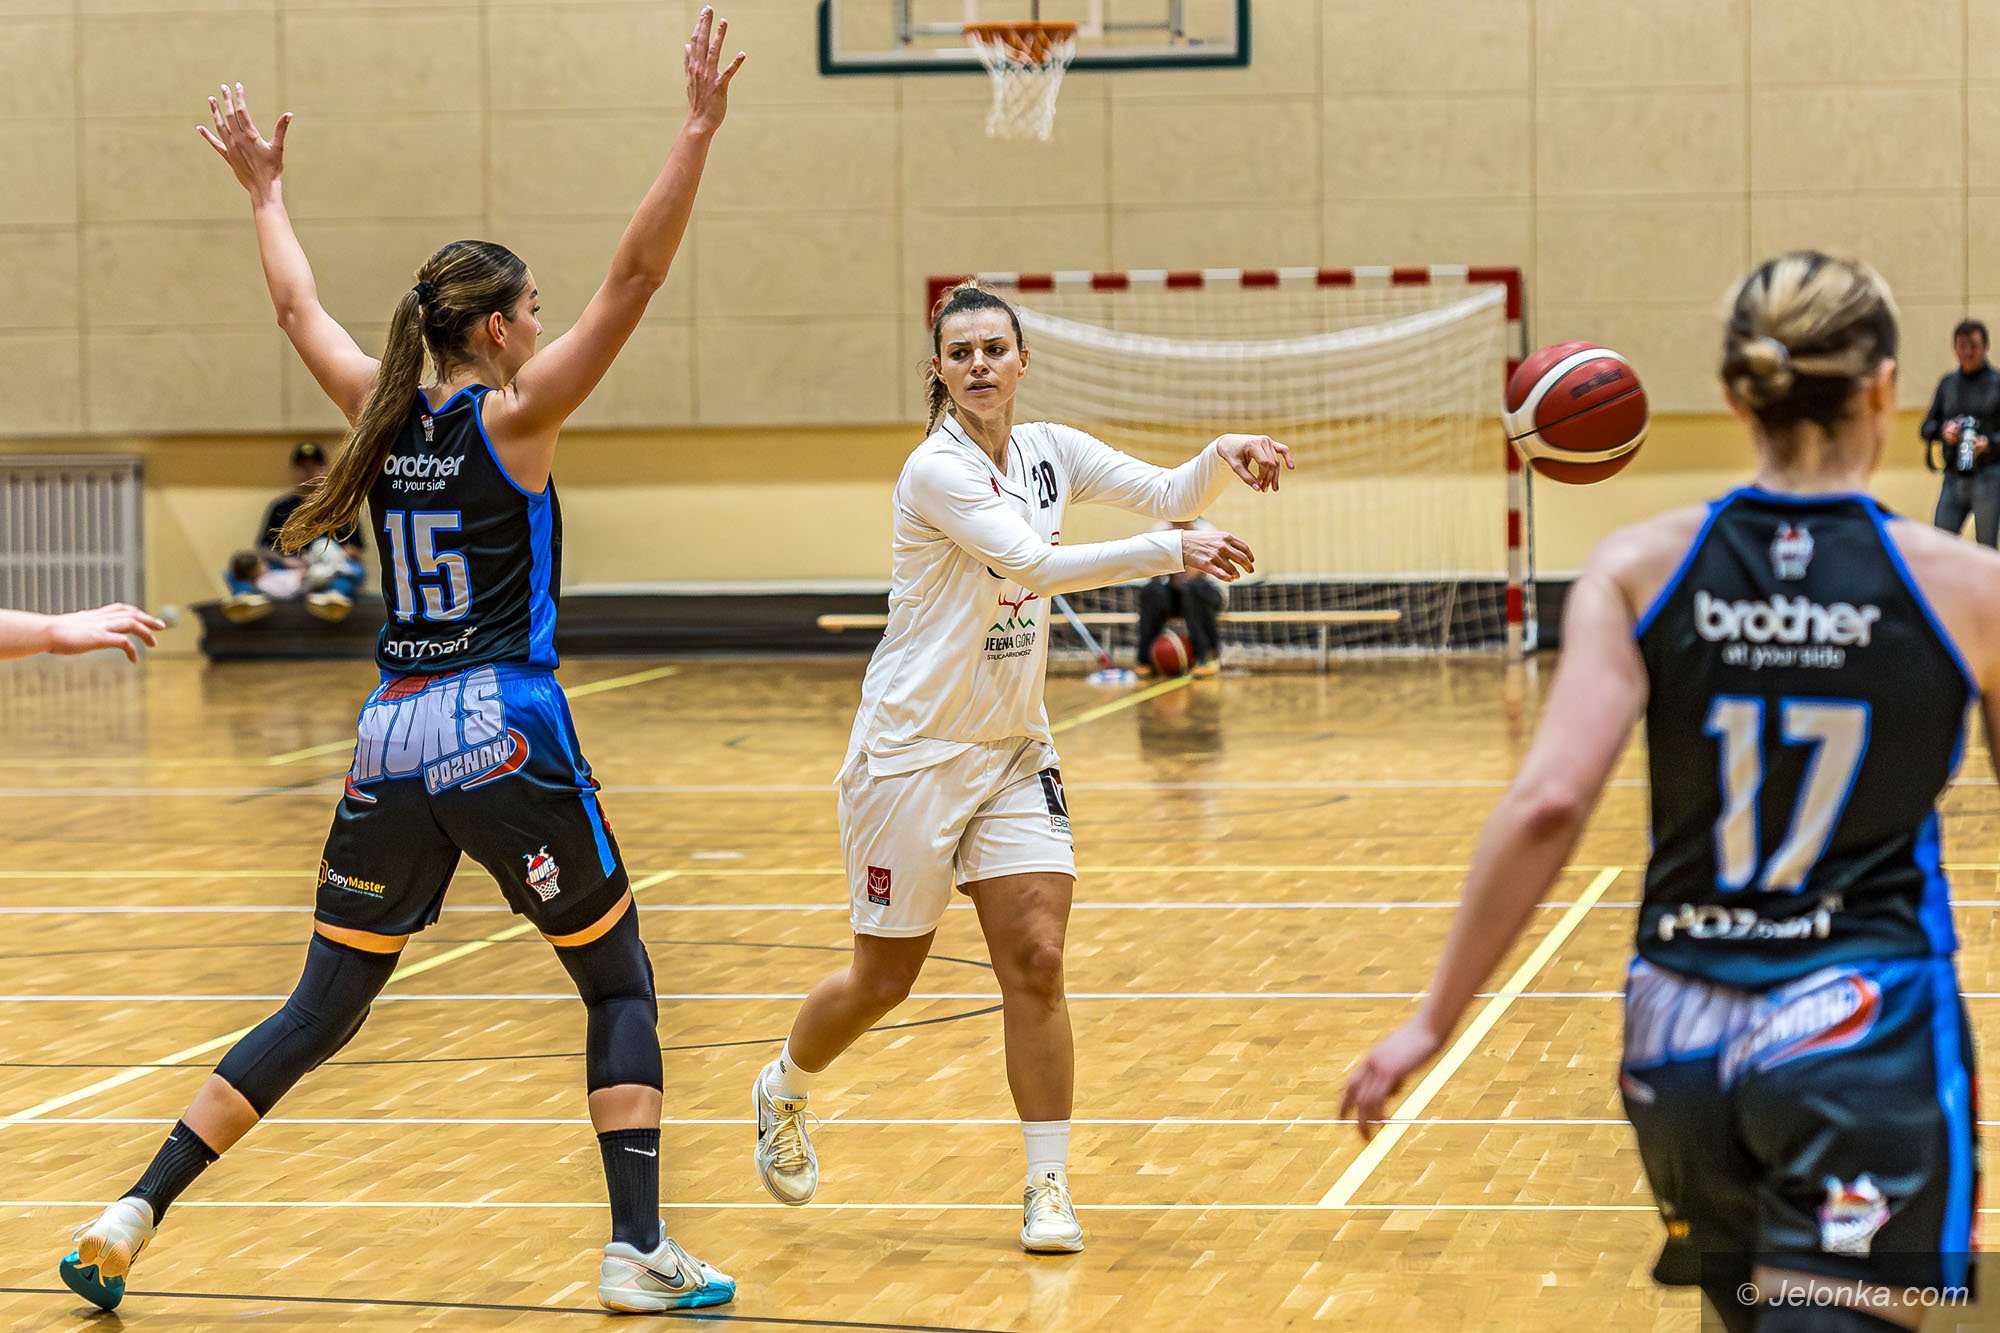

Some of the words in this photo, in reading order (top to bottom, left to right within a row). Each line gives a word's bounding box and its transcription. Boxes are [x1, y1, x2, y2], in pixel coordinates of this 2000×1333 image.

[392, 479, 403, 489] at
[404, 481, 426, 493] your
[427, 479, 446, 490] side
[1032, 460, 1058, 509] 20
[384, 510, 472, 622] 15
[1694, 590, 1882, 647] brother
[1704, 694, 1871, 892] 17
[327, 868, 386, 894] CopyMaster
